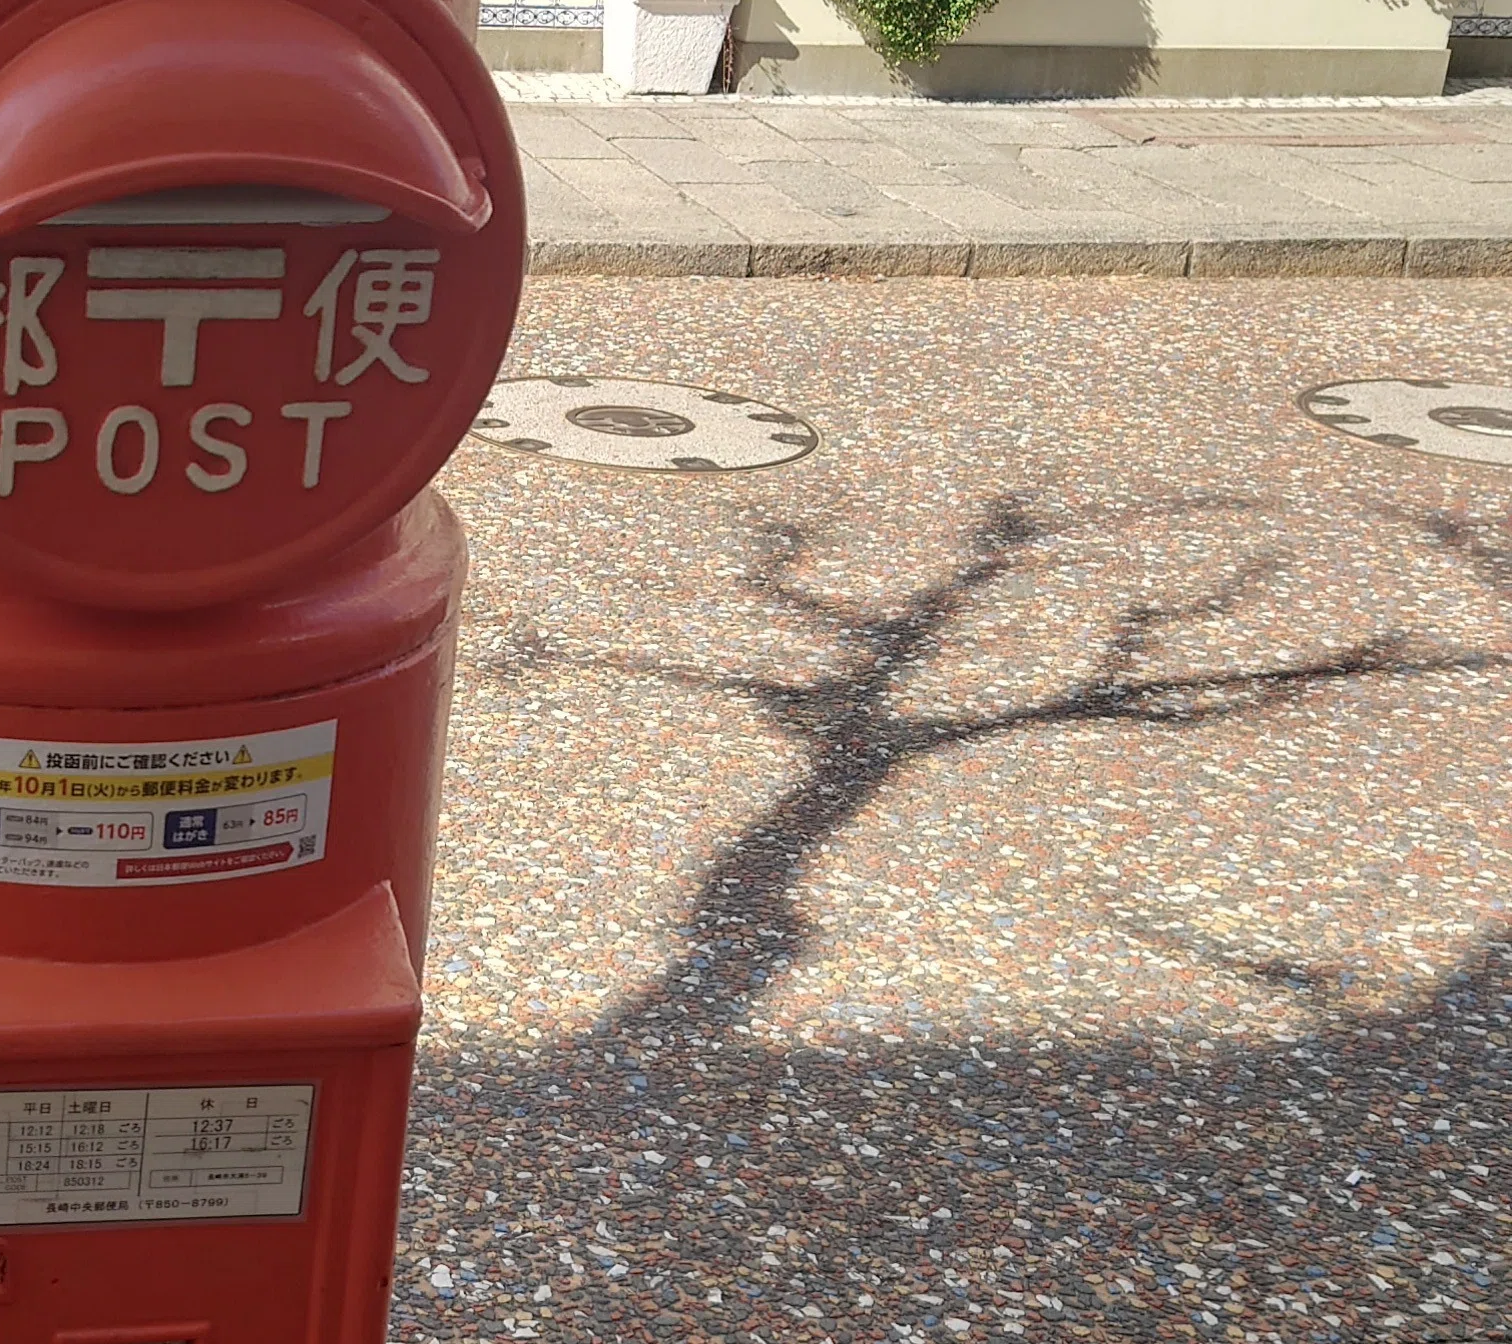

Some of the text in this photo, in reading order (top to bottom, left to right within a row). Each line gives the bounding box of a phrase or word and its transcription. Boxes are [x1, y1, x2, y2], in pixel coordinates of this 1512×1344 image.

[46, 750, 230, 770] 投函前にご確認ください
[25, 814, 48, 827] 84円
[263, 807, 299, 827] 85円
[96, 821, 146, 841] 110円
[172, 828, 210, 843] はがき
[24, 832, 48, 845] 94円
[23, 1102, 52, 1115] 平日
[68, 1101, 112, 1114] 土曜日
[20, 1125, 53, 1136] 12:12
[73, 1124, 105, 1135] 12:18
[119, 1123, 142, 1134] ごろ
[193, 1118, 295, 1133] 12:37 ごろ
[19, 1143, 52, 1154] 15:15
[71, 1141, 104, 1152] 16:12
[117, 1140, 140, 1151] ごろ
[191, 1135, 293, 1150] 16:17 ごろ
[70, 1158, 102, 1169] 18:15
[116, 1157, 138, 1168] ごろ
[63, 1176, 105, 1187] 850312
[46, 1200, 129, 1213] 長崎中央郵便局
